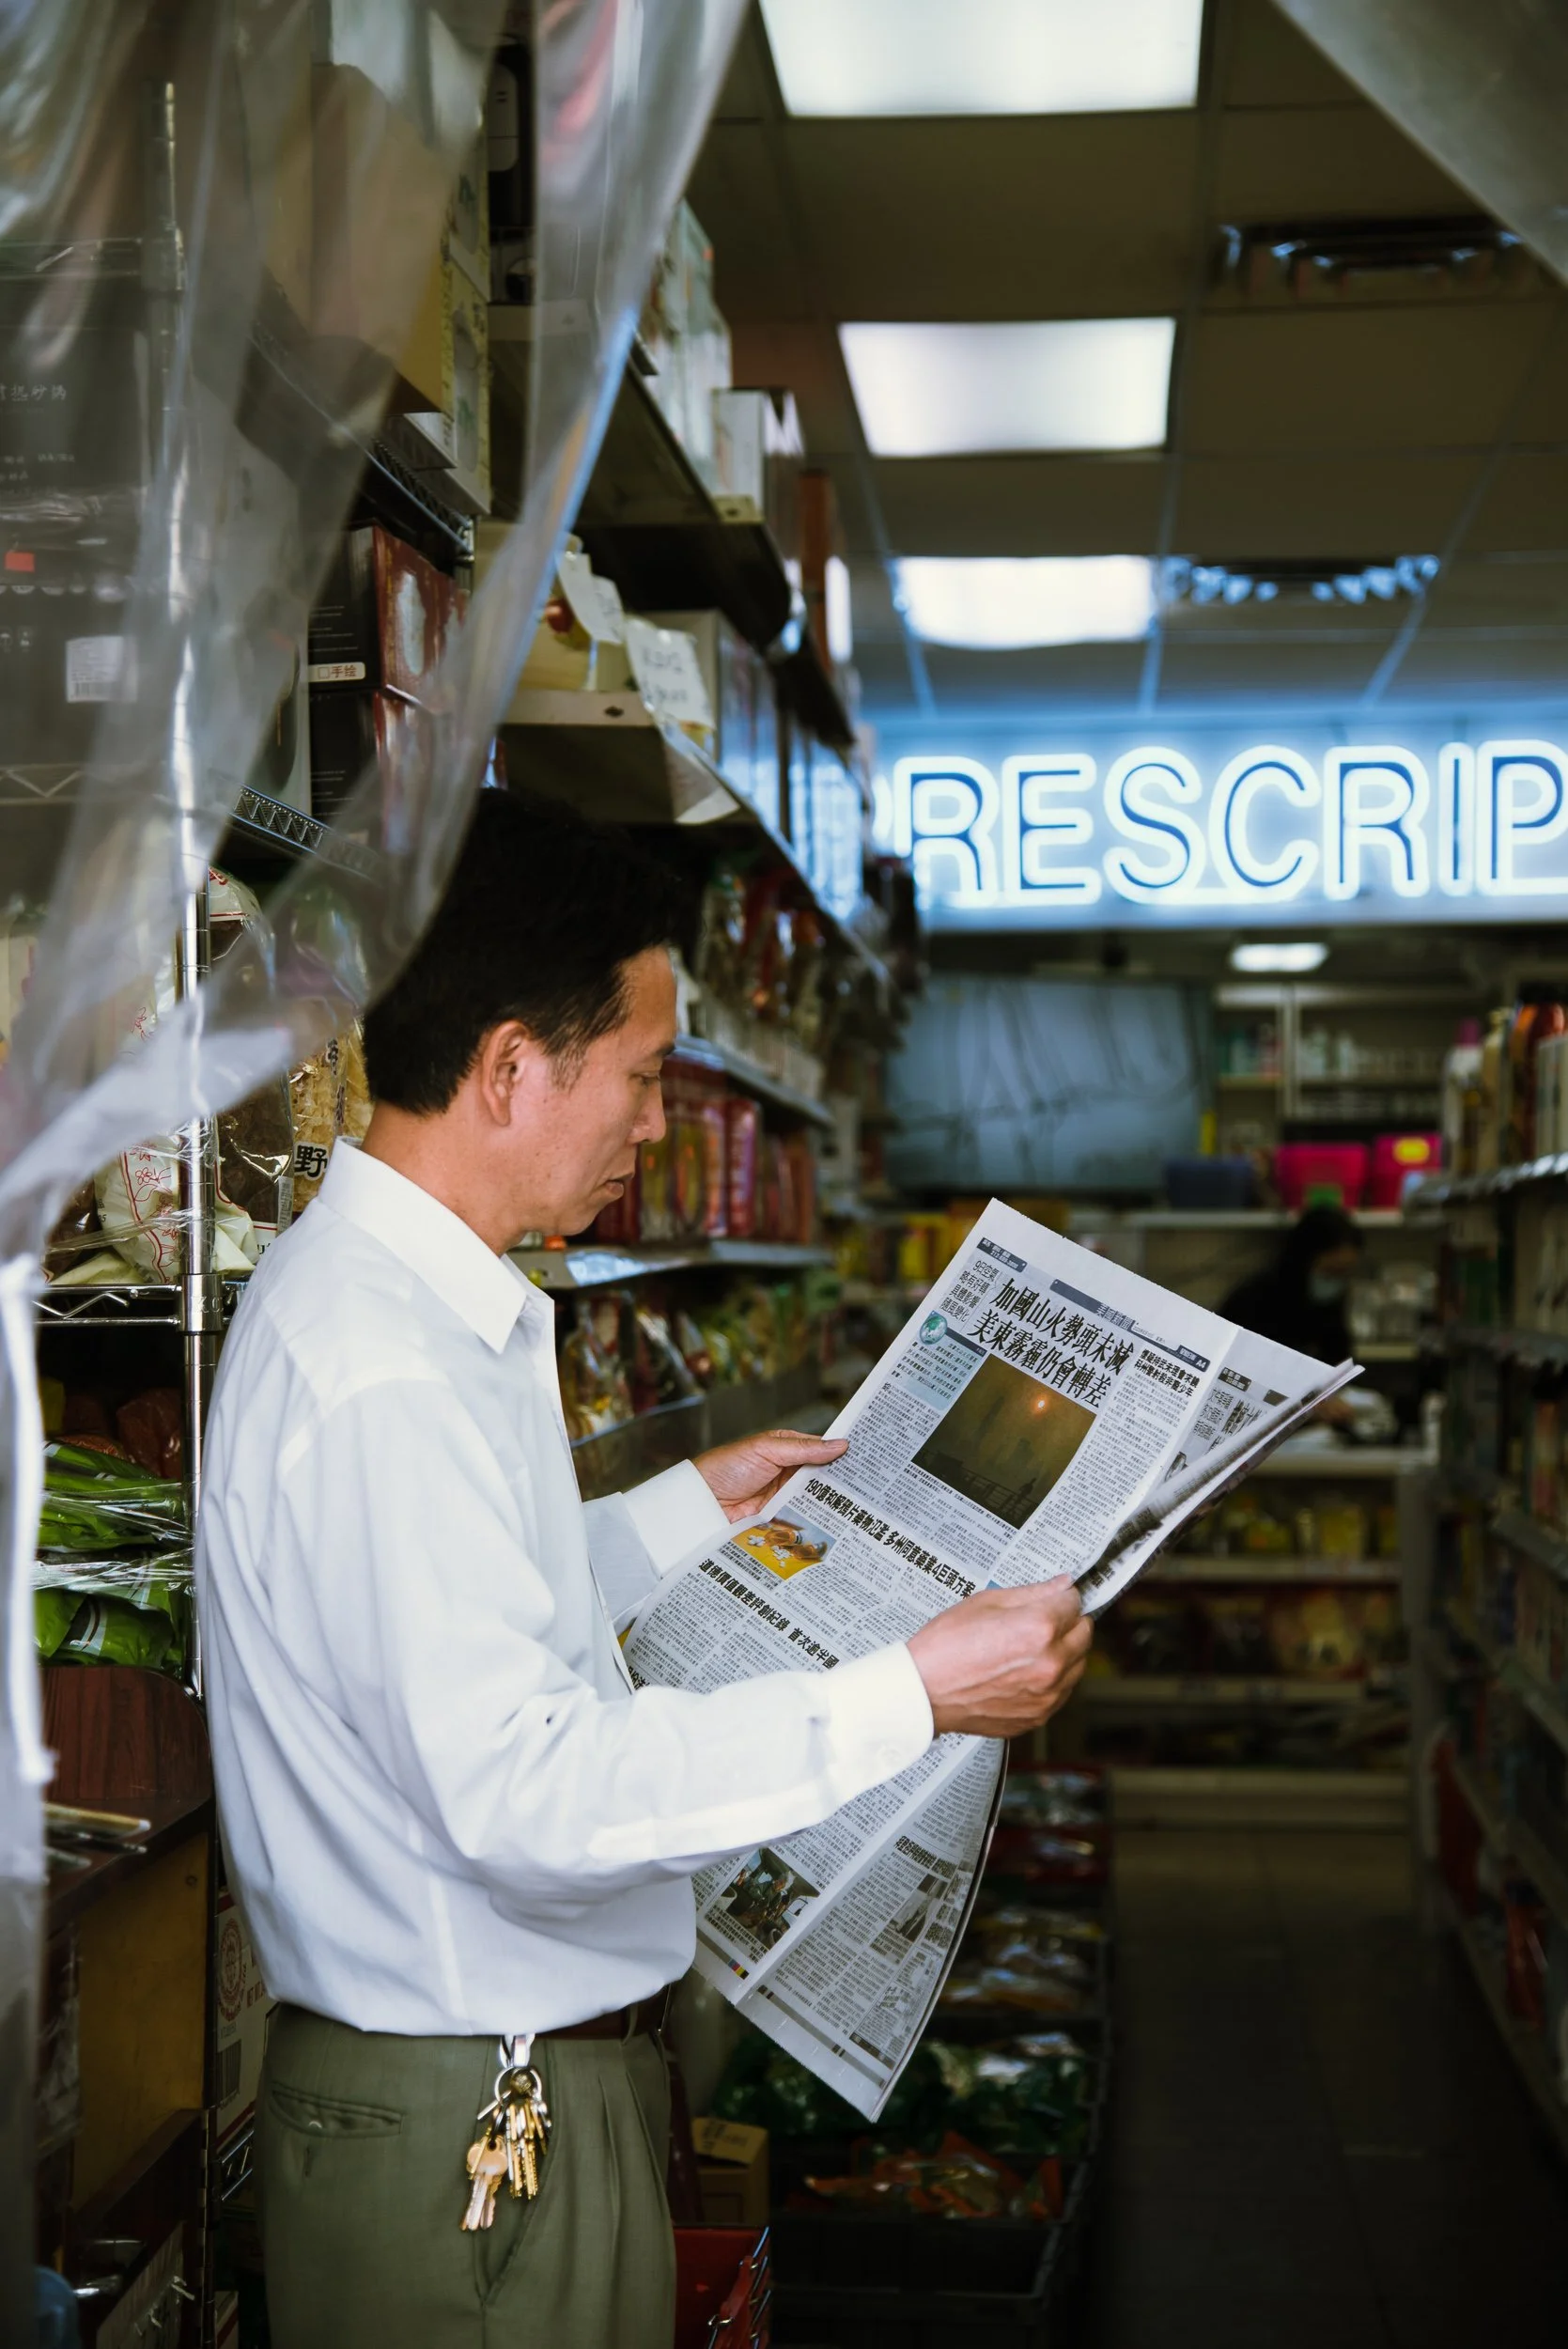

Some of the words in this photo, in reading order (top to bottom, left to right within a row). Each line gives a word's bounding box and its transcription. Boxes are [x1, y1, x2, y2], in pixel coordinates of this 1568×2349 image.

[870, 739, 1568, 910] RESCRIP
[294, 1144, 328, 1178] 野
[966, 1309, 1114, 1408] 美東霧霾仍會轉差
[988, 1277, 1136, 1376] 加國山火勢頭未減
[1195, 1359, 1206, 1368] A4
